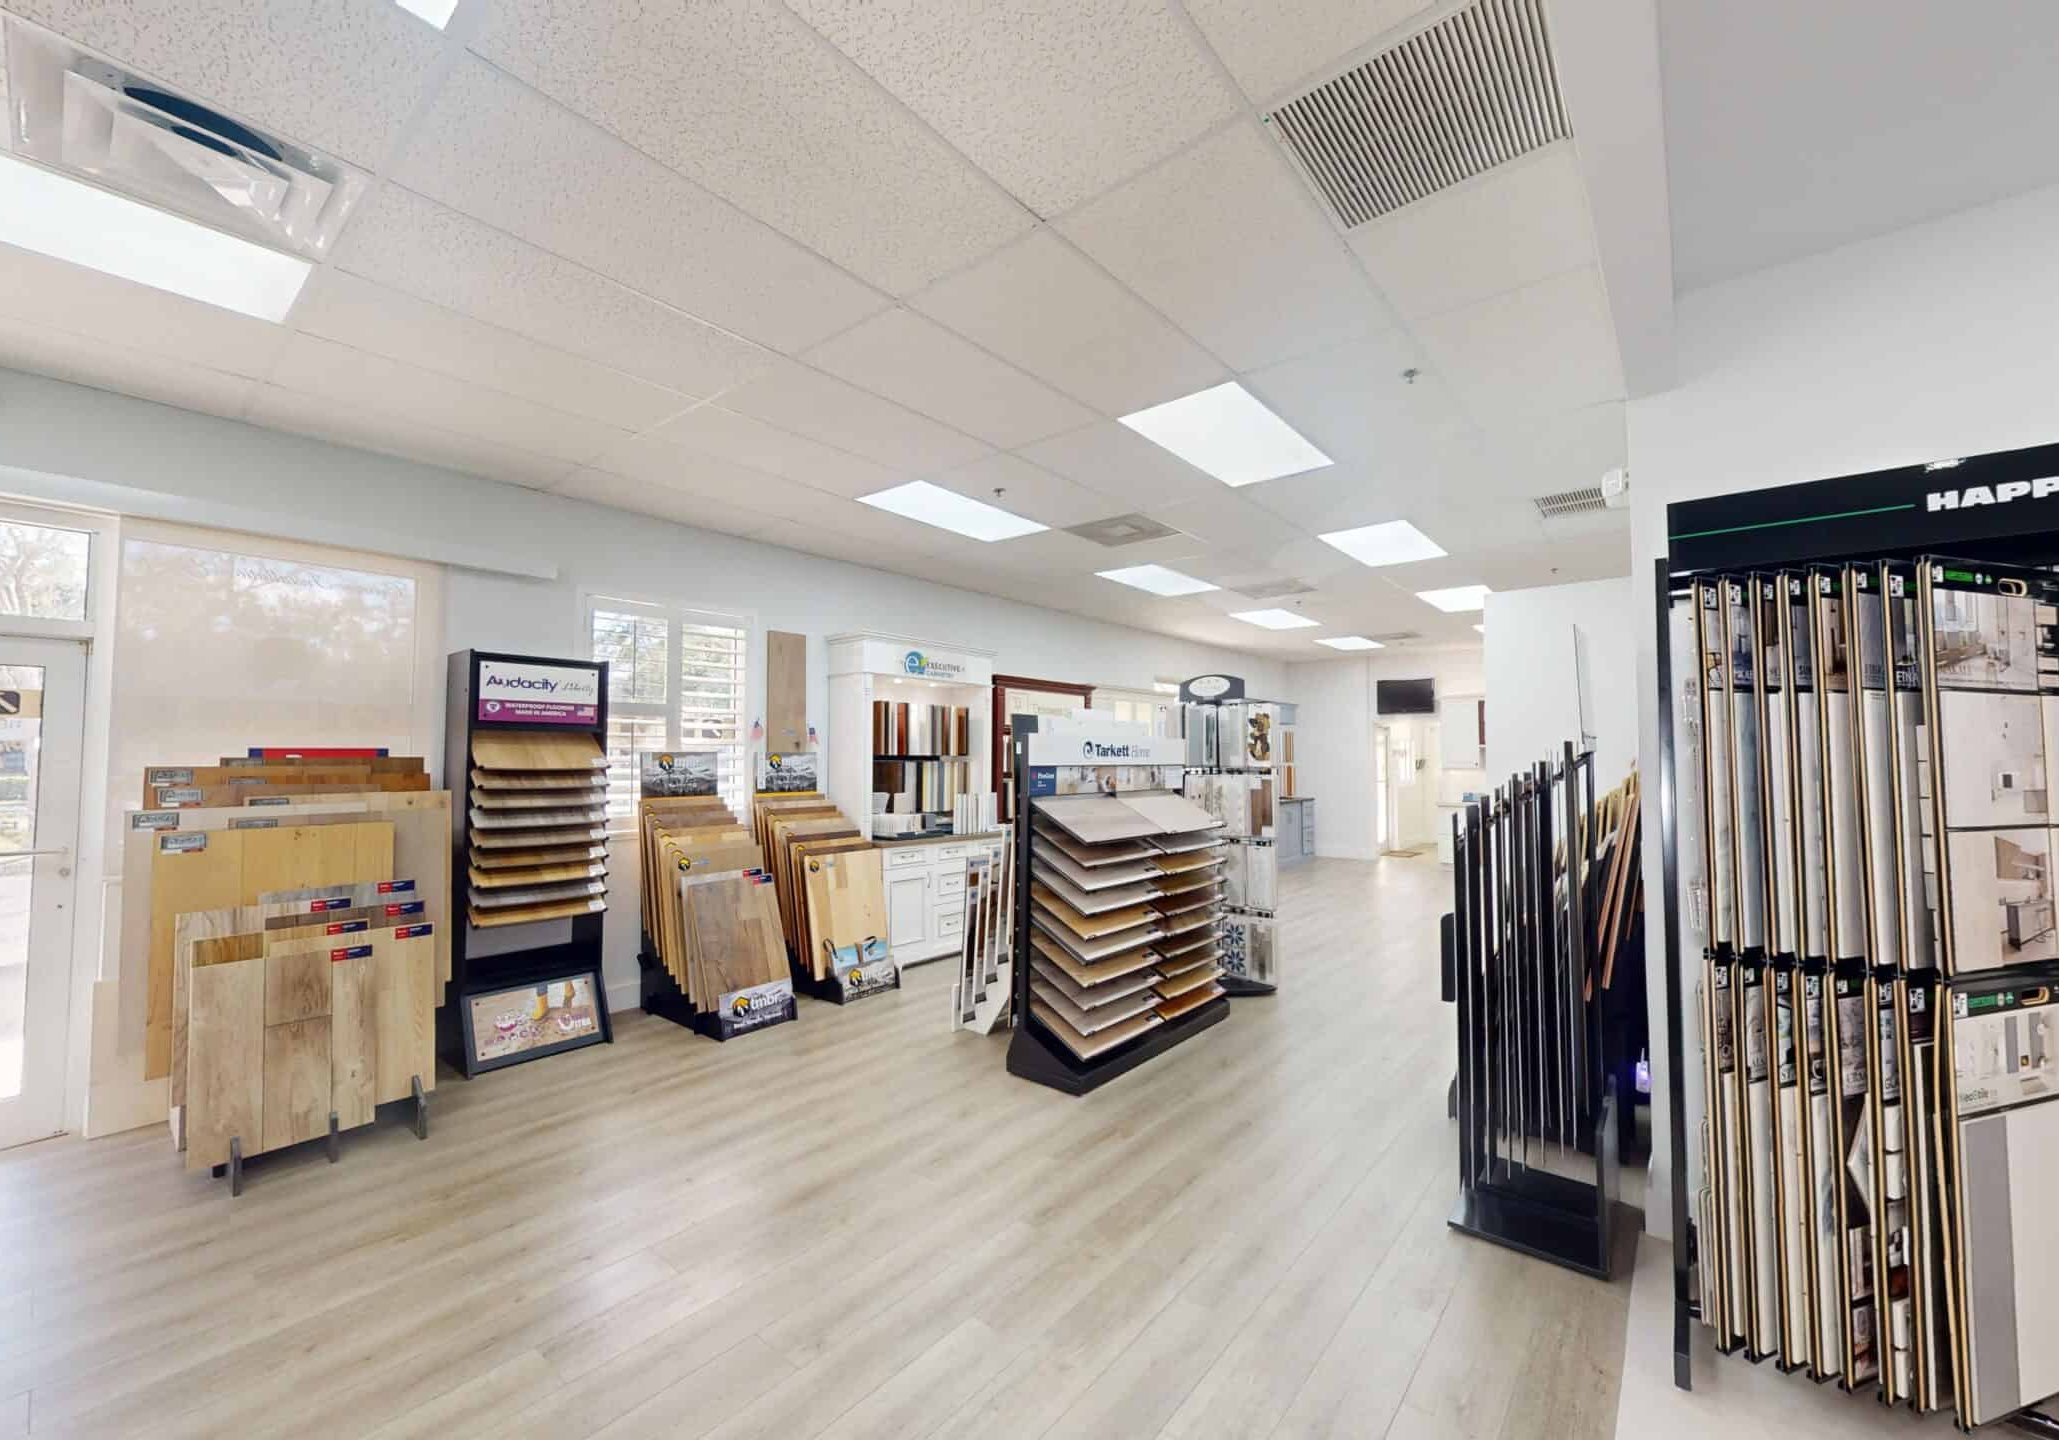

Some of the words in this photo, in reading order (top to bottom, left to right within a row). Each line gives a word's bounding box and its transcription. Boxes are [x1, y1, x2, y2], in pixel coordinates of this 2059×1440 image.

[1927, 475, 2059, 512] HAPP
[486, 675, 558, 693] Audacity
[1094, 743, 1130, 758] Tarkett
